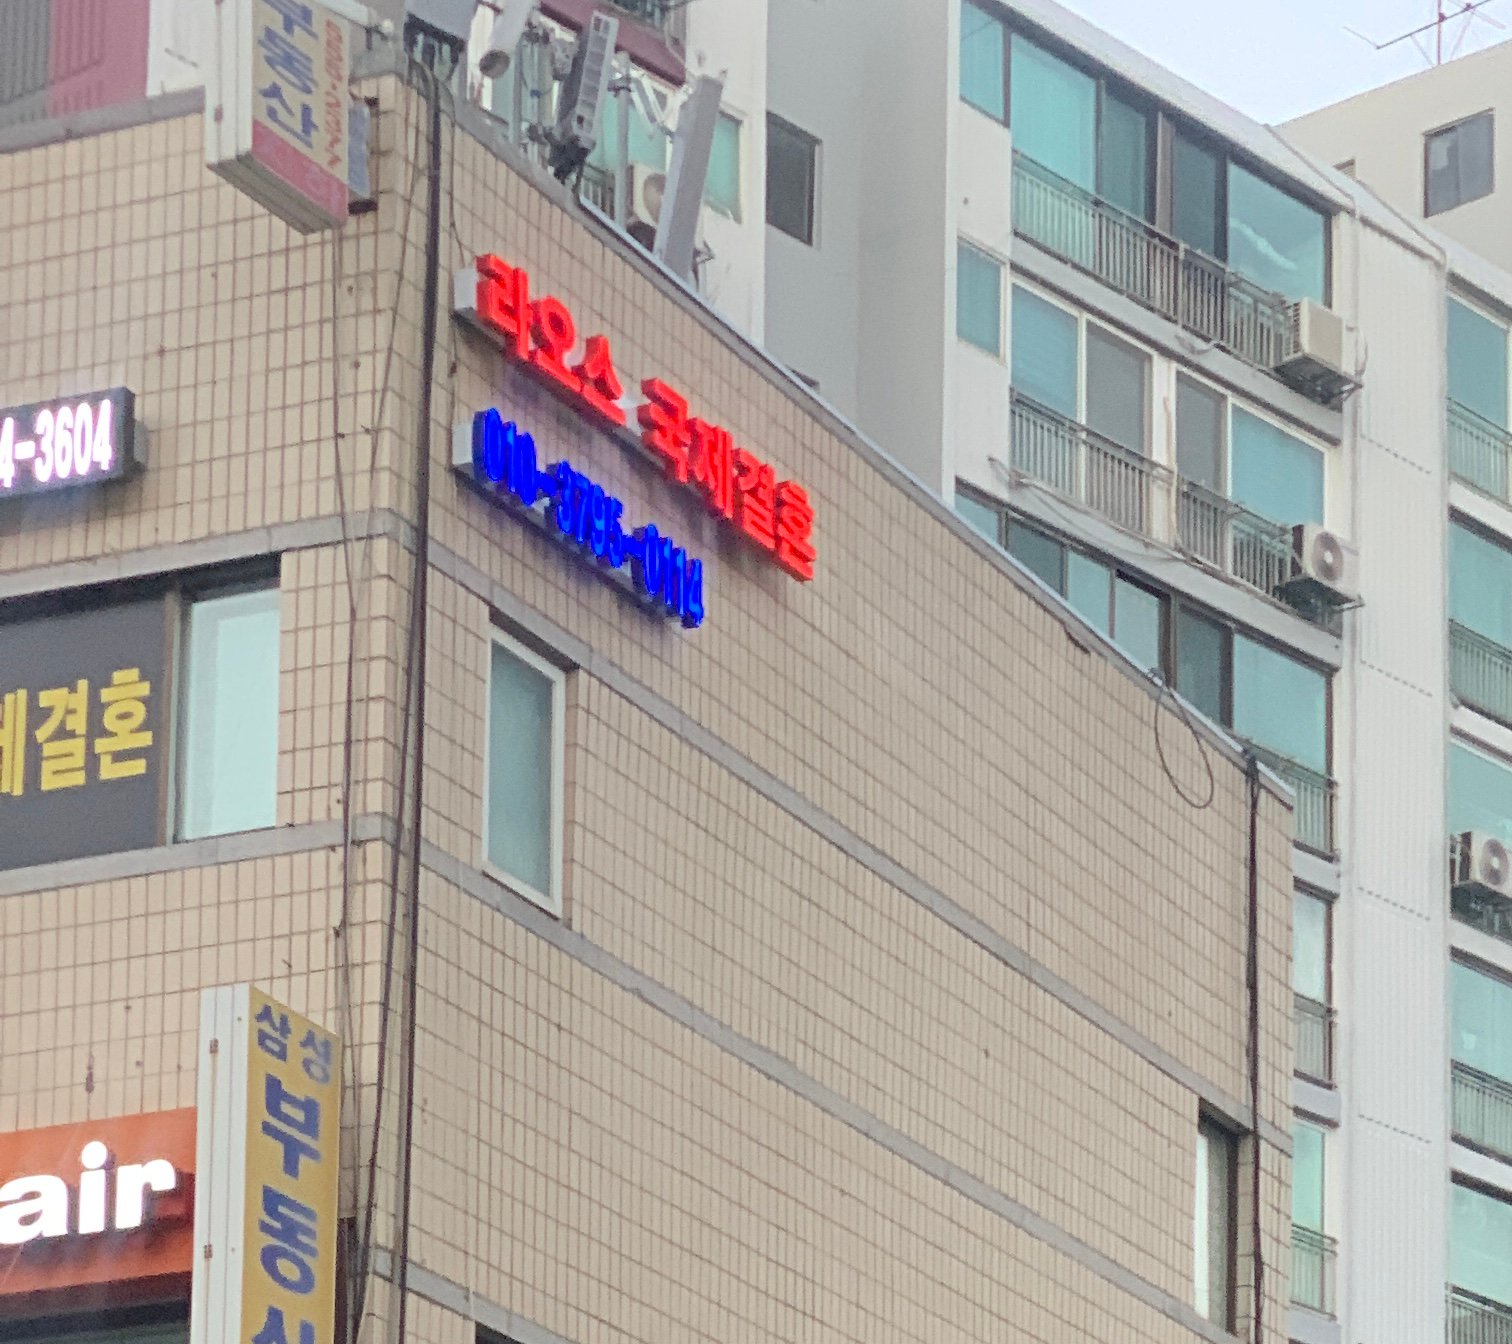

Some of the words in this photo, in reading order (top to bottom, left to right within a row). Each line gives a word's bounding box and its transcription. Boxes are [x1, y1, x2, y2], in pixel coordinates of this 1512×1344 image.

[476, 253, 627, 427] 라오스
[637, 377, 817, 582] 국제결혼
[255, 1004, 333, 1085] 삼성
